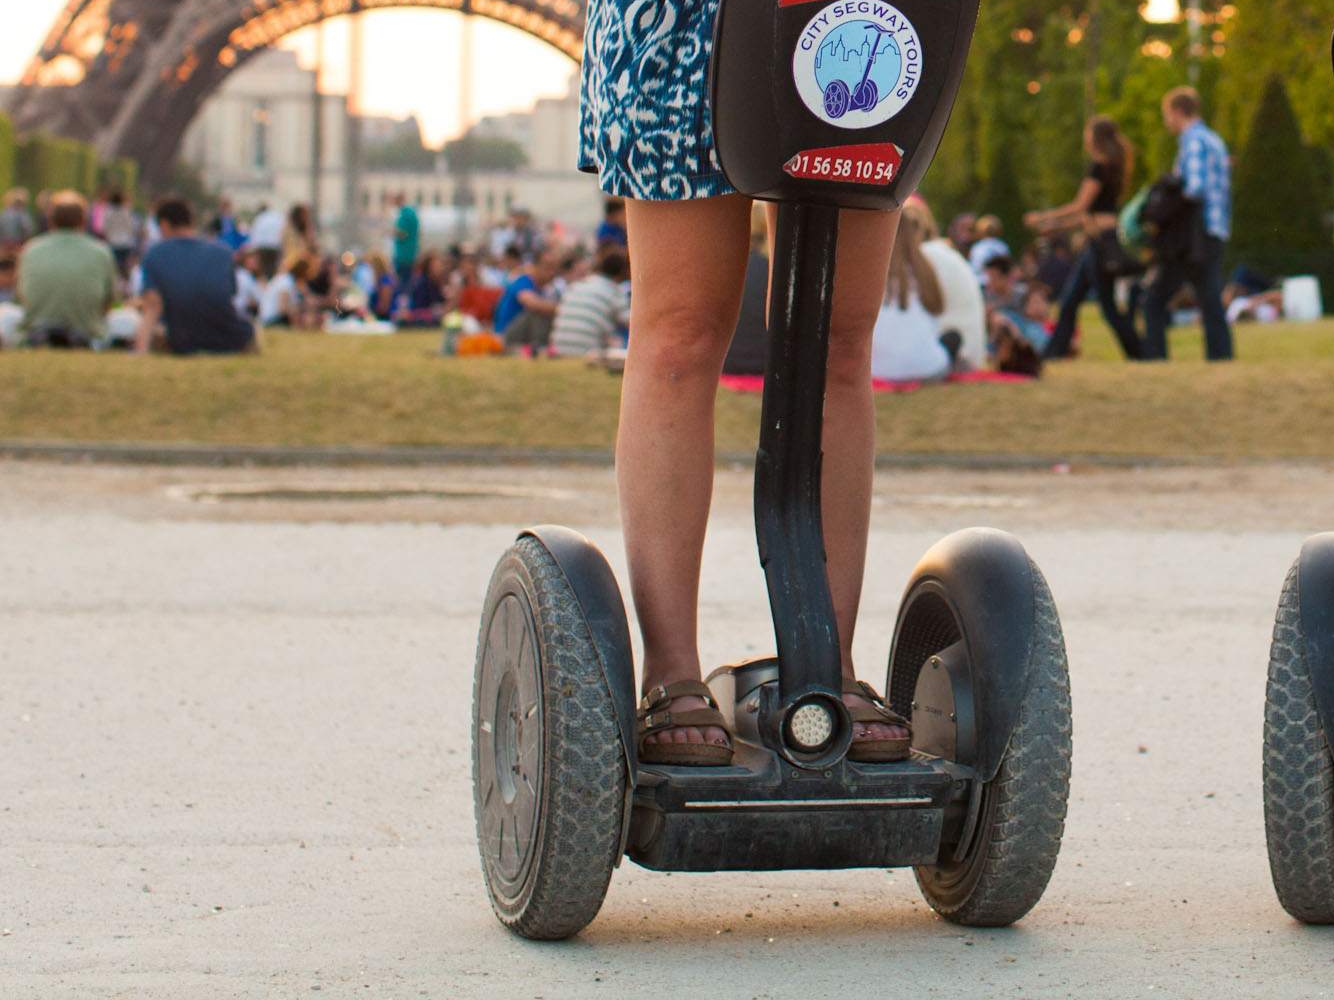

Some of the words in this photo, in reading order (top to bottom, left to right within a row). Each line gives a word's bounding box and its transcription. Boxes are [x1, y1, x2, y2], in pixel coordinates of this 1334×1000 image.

[801, 13, 829, 51] CITY
[833, 1, 909, 34] SEGWAY
[896, 35, 918, 100] TOURS
[791, 155, 809, 173] 01
[812, 156, 831, 175] 56
[832, 158, 852, 177] 58
[855, 160, 873, 179] 10
[874, 162, 893, 180] 54
